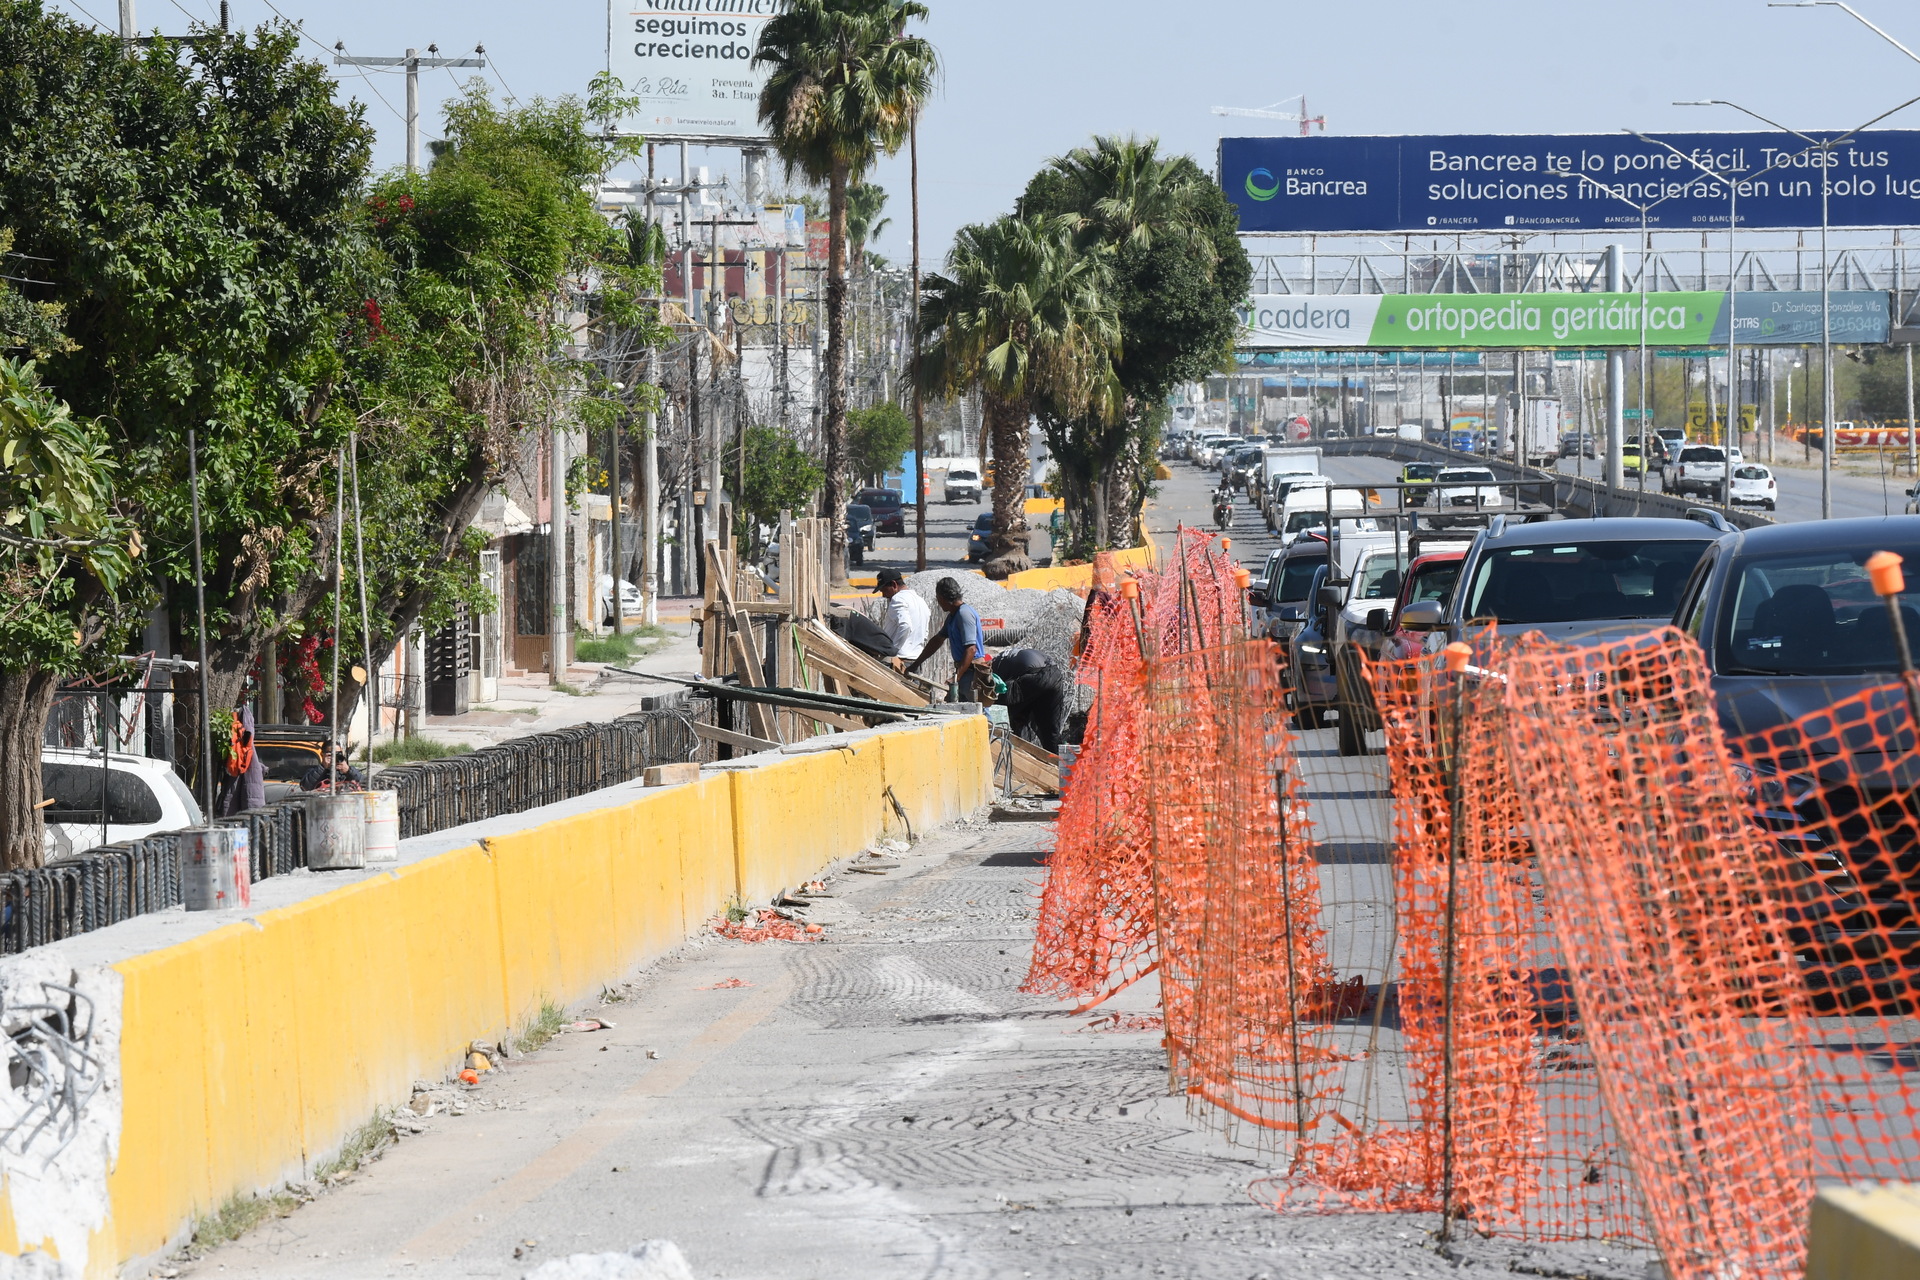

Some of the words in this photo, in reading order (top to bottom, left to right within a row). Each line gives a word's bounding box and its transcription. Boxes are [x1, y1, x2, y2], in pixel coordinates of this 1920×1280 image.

[635, 17, 747, 37] seguimos
[634, 39, 751, 60] creciendo
[630, 77, 651, 95] La
[711, 79, 753, 88] Preventa
[711, 90, 728, 99] 3a.
[1429, 150, 1537, 172] Bancrea
[1546, 152, 1572, 171] te
[1581, 150, 1604, 170] lo
[1614, 151, 1682, 174] pone
[1691, 148, 1751, 170] fácil.
[1760, 148, 1839, 168] Todas
[1848, 147, 1889, 167] tus
[1286, 168, 1324, 176] BANCO
[1286, 178, 1367, 196] Bancrea
[1428, 178, 1568, 200] soluciones
[1577, 176, 1728, 200] financieras,
[1737, 181, 1769, 197] en
[1779, 180, 1812, 197] un
[1821, 175, 1876, 196] solo
[1259, 302, 1350, 329] cadera
[1772, 302, 1784, 313] Dr.
[1786, 301, 1822, 315] Santiago
[1406, 301, 1541, 338] ortopedia
[1550, 300, 1686, 339] geriátrica
[1733, 317, 1759, 329] CITAS
